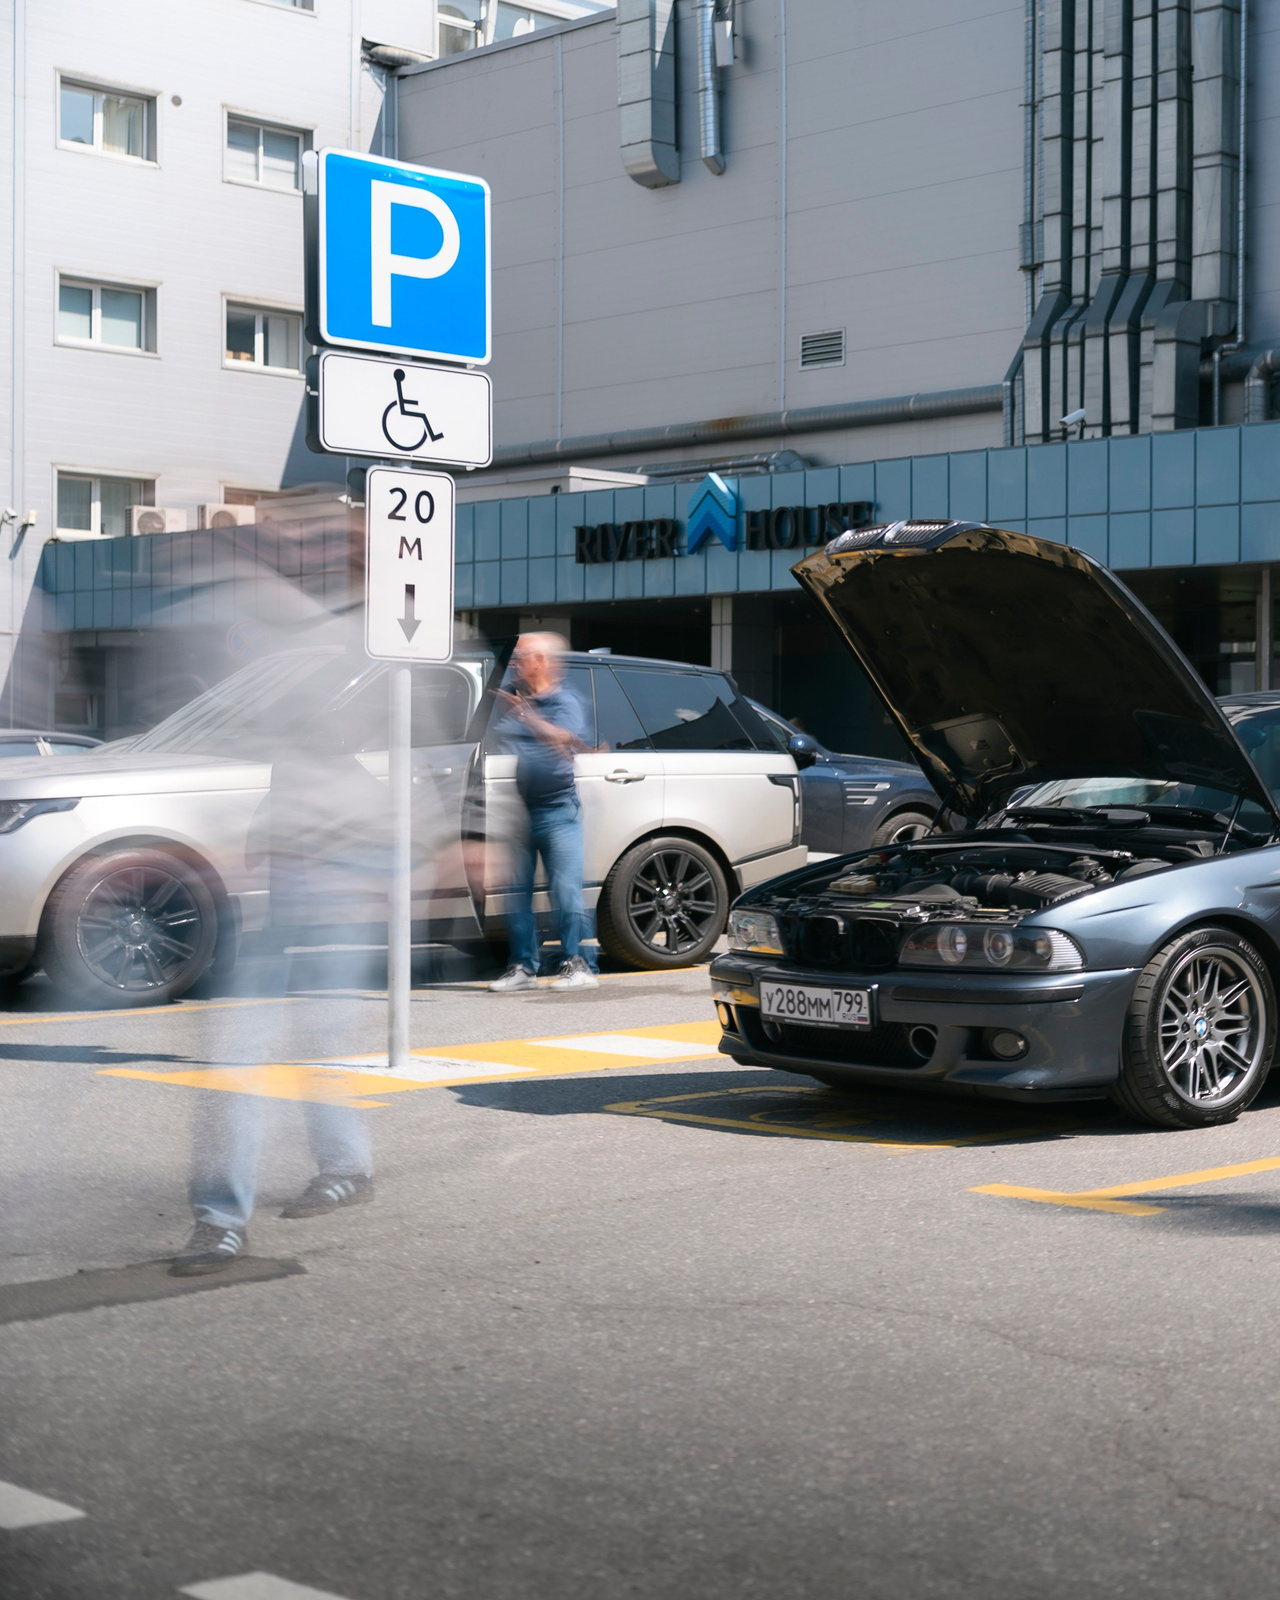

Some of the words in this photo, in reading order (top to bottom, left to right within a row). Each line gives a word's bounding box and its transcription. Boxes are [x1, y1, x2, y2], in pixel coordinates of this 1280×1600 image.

[371, 178, 460, 328] P
[387, 487, 435, 524] 20
[573, 518, 680, 564] RIVER
[834, 991, 863, 1013] 799
[842, 1013, 857, 1022] RUS
